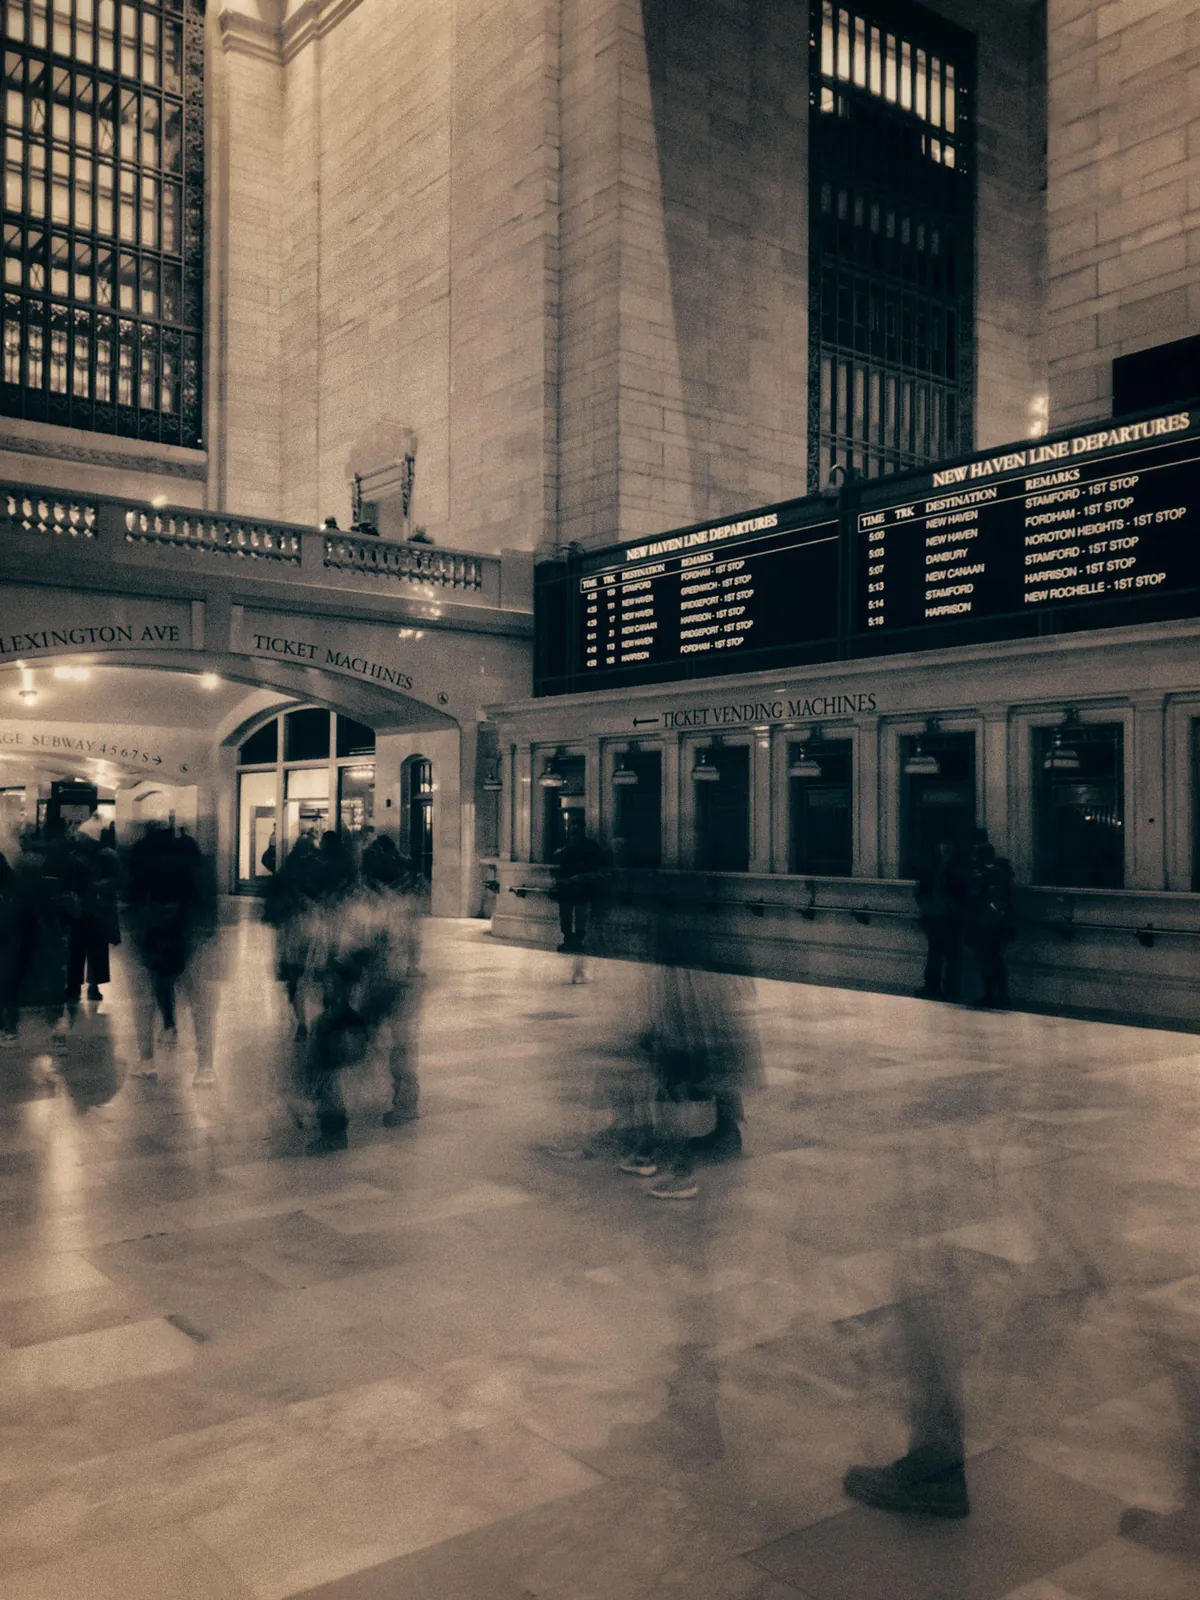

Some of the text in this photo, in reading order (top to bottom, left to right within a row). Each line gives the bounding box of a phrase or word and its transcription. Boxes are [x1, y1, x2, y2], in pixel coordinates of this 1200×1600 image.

[933, 412, 1190, 487] NEW HAVEN LINE DEPARTURES
[862, 469, 1080, 527] TIME TRK DESTINATION REMARKS
[1025, 488, 1080, 508] STAMFORD
[1089, 482, 1107, 495] 1ST
[1109, 476, 1139, 491] STOP
[926, 517, 947, 529] NEW
[947, 510, 978, 524] HAVEN
[1025, 509, 1075, 527] FORDHAM
[1084, 503, 1102, 515] 1ST
[1105, 497, 1134, 512] STOP
[1025, 528, 1075, 546] NOROTON
[1077, 519, 1124, 536] HEIGHTS
[1134, 513, 1152, 526] 1ST
[1156, 507, 1186, 522] STOP
[626, 513, 778, 561] NEW HAVEN LINE DEPARTURES
[926, 535, 947, 546] NEW
[948, 528, 978, 542] HAVEN
[926, 548, 968, 564] DANBURY
[1025, 547, 1080, 565] STAMFORD
[1089, 542, 1106, 553] 1ST
[1110, 536, 1139, 551] STOP
[621, 563, 665, 580] DESTINATION
[681, 552, 714, 567] REMARKS
[680, 568, 711, 580] FORDHAM
[716, 564, 726, 573] 1ST
[726, 560, 744, 571] STOP
[926, 570, 946, 582] NEW
[947, 564, 984, 577] CANAAN
[1025, 567, 1077, 583] HARRISON
[1086, 562, 1104, 574] 1ST
[1107, 557, 1136, 571] STOP
[622, 580, 651, 593] STAMFORD
[681, 582, 717, 595] GREENWICH
[722, 578, 733, 587] 1ST
[734, 575, 752, 585] STOP
[926, 584, 973, 600] STAMFORD
[1025, 590, 1048, 602] NEW
[1050, 582, 1104, 598] ROCHELLE
[1114, 577, 1133, 589] 1ST
[1136, 573, 1166, 587] STOP
[622, 598, 635, 606] NEW
[635, 595, 653, 604] HAVEN
[681, 596, 719, 610] BRIDGEPORT
[724, 593, 735, 601] 1ST
[736, 589, 754, 600] STOP
[925, 602, 971, 617] HARRISON
[622, 612, 635, 620] NEW
[635, 609, 653, 617] HAVEN
[681, 613, 711, 624] HARRISON
[716, 609, 727, 618] 1ST
[728, 606, 745, 616] STOP
[0, 625, 180, 654] LEXINGTON AVE
[622, 625, 635, 634] NEW
[681, 626, 719, 639] BRIDGEPORT
[724, 623, 735, 632] 1ST
[736, 620, 753, 630] STOP
[622, 640, 635, 648] NEW
[635, 637, 653, 645] HAVEN
[680, 642, 710, 653] FORDHAM
[715, 639, 725, 648] 1ST
[727, 637, 744, 647] STOP
[253, 634, 413, 690] TICKET MACHINES
[621, 652, 649, 661] HARRISON
[662, 693, 876, 728] TICKET VENDING MACHINES
[32, 734, 96, 751] SUBWAY
[132, 749, 138, 759] 7
[142, 752, 149, 763] S
